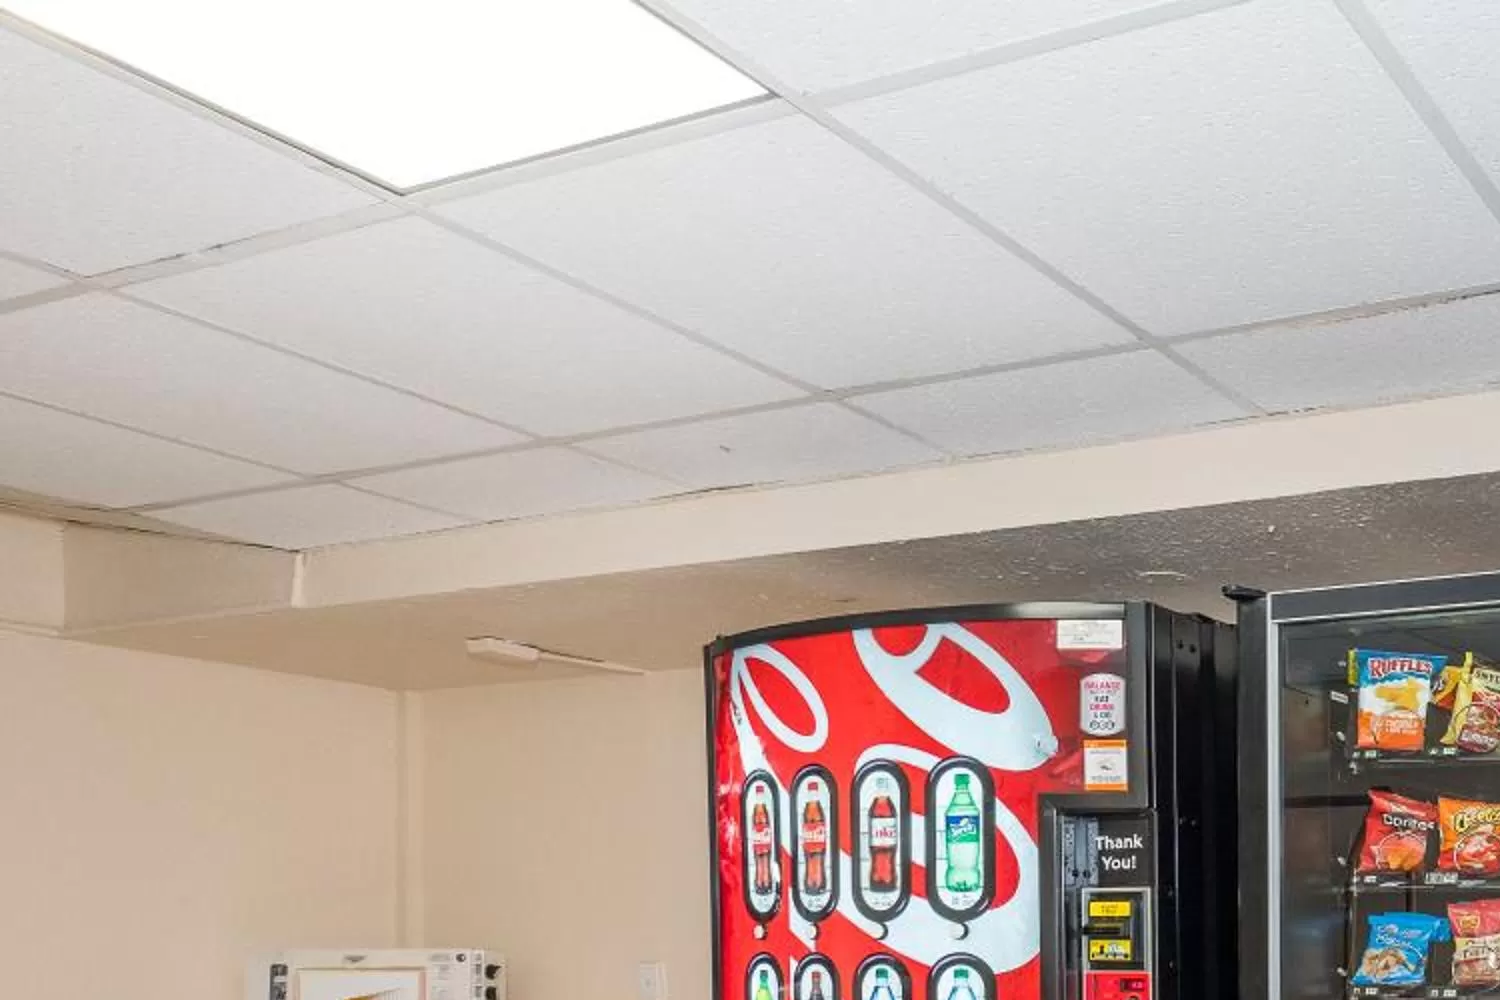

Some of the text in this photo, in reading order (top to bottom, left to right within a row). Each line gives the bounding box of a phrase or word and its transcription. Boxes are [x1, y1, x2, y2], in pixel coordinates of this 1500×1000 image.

[1368, 656, 1433, 679] RUFFLES
[1383, 813, 1435, 831] Doritos
[1095, 833, 1144, 860] Thank
[1101, 856, 1138, 871] You!
